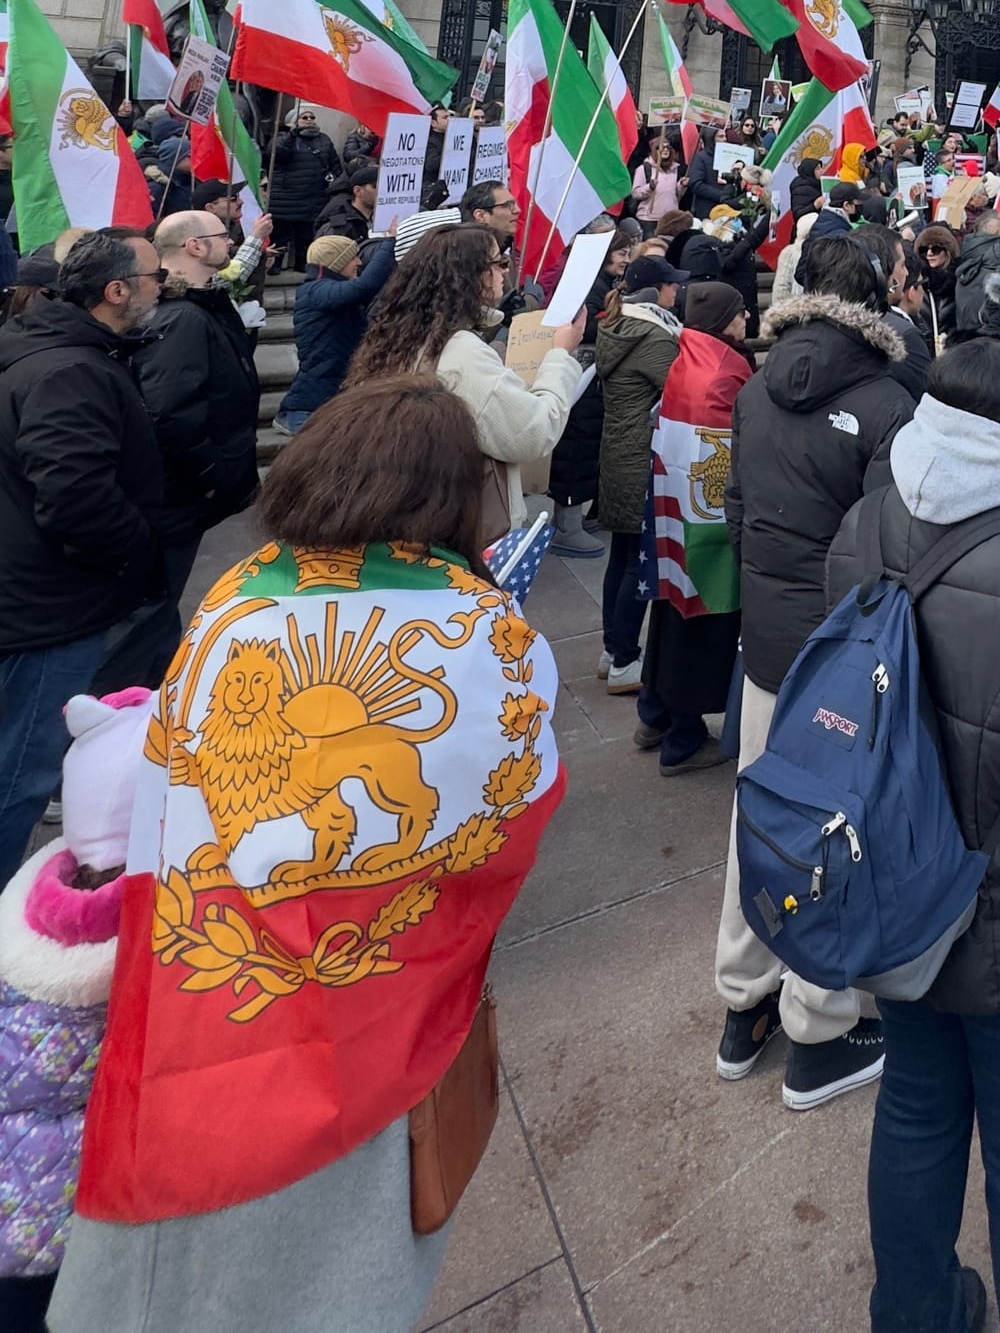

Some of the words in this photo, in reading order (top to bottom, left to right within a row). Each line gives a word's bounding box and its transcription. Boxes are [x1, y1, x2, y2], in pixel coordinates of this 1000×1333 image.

[398, 133, 415, 151] NO
[453, 136, 465, 151] WE
[478, 143, 504, 159] REGIME
[382, 157, 424, 167] NEGOTIATIONS
[444, 168, 466, 185] WANT
[474, 165, 501, 181] CHANGE
[387, 173, 416, 193] WITH
[813, 708, 859, 737] JANSPORT
